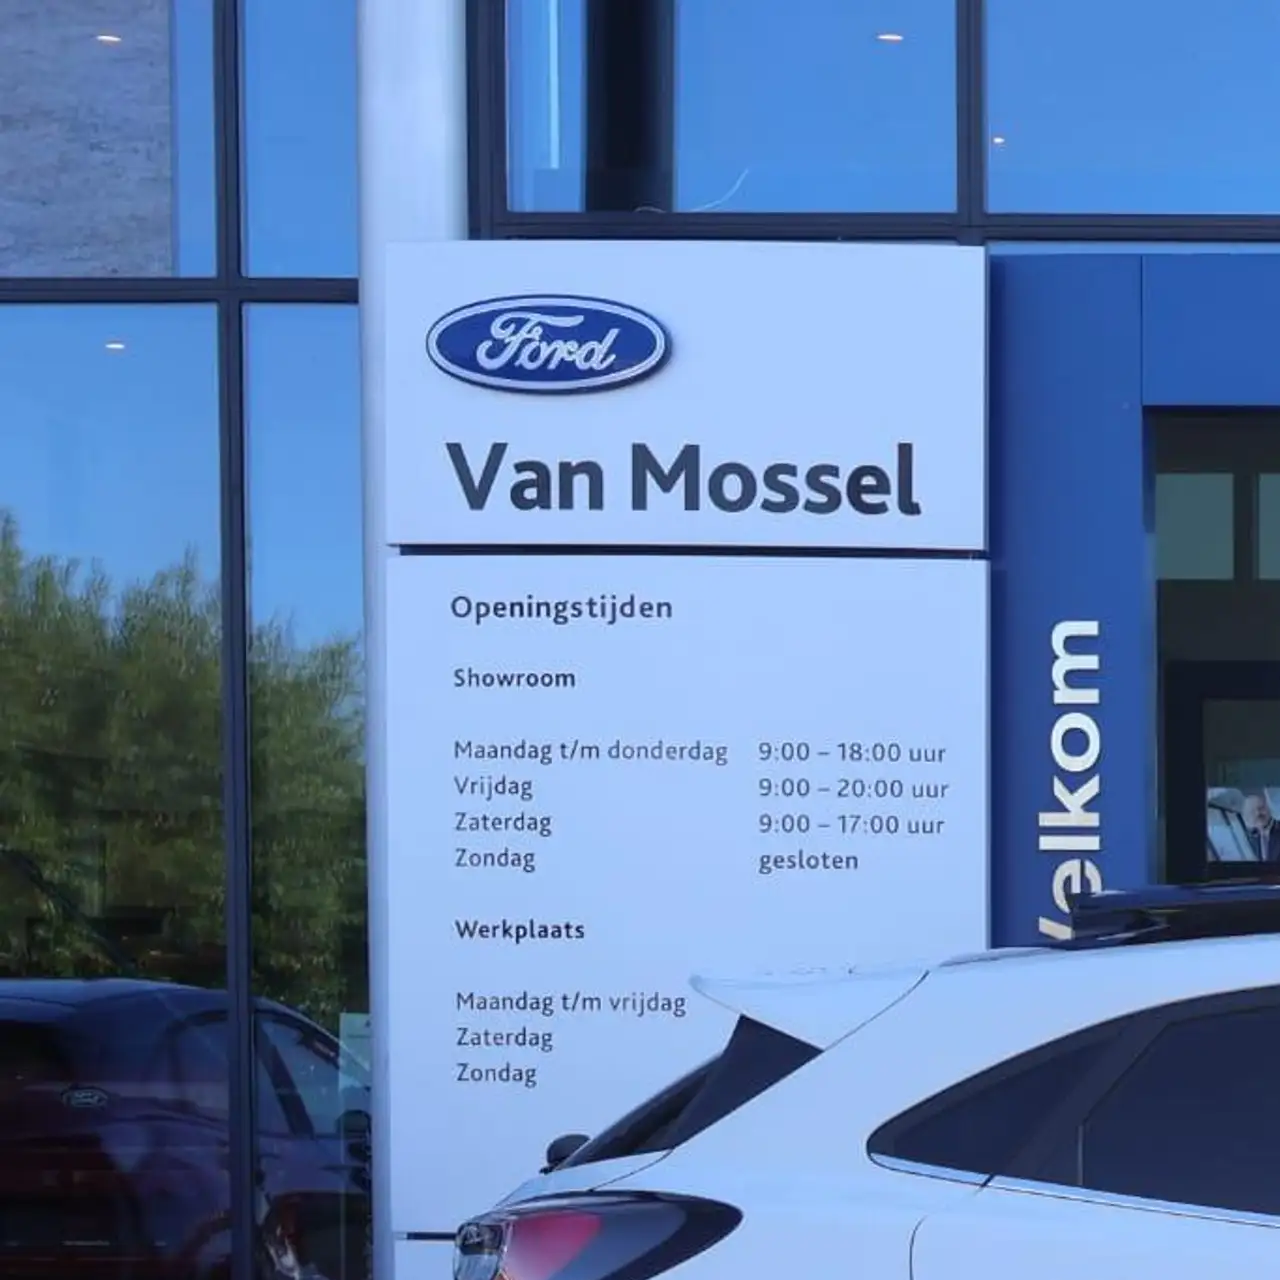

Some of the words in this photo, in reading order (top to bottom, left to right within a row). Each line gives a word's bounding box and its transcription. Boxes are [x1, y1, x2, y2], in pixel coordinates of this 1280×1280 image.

[476, 310, 621, 371] Ford
[446, 442, 604, 511] Van
[632, 443, 922, 516] Mossel
[451, 594, 673, 624] Openingstijden
[453, 667, 577, 688] Showroom
[454, 738, 552, 766] Maandag
[560, 739, 599, 761] t/m
[607, 739, 728, 767] donderdag
[758, 741, 810, 762] 9:00
[837, 742, 902, 763] 18:00
[909, 748, 947, 763] uur
[454, 774, 534, 802] Vrijdag
[758, 777, 811, 798] 9:00
[837, 778, 904, 799] 20:00
[911, 784, 950, 799] uur
[454, 810, 553, 838] Zaterdag
[758, 813, 811, 834] 9:00
[837, 814, 900, 835] 17:00
[908, 819, 946, 835] uur
[454, 846, 536, 874] Zondag
[758, 848, 860, 875] gesloten
[454, 918, 586, 944] Werkplaats
[456, 990, 555, 1017] Maandag
[561, 990, 602, 1012] t/m
[608, 990, 688, 1018] vrijdag
[456, 1025, 554, 1053] Zaterdag
[456, 1061, 538, 1089] Zondag
